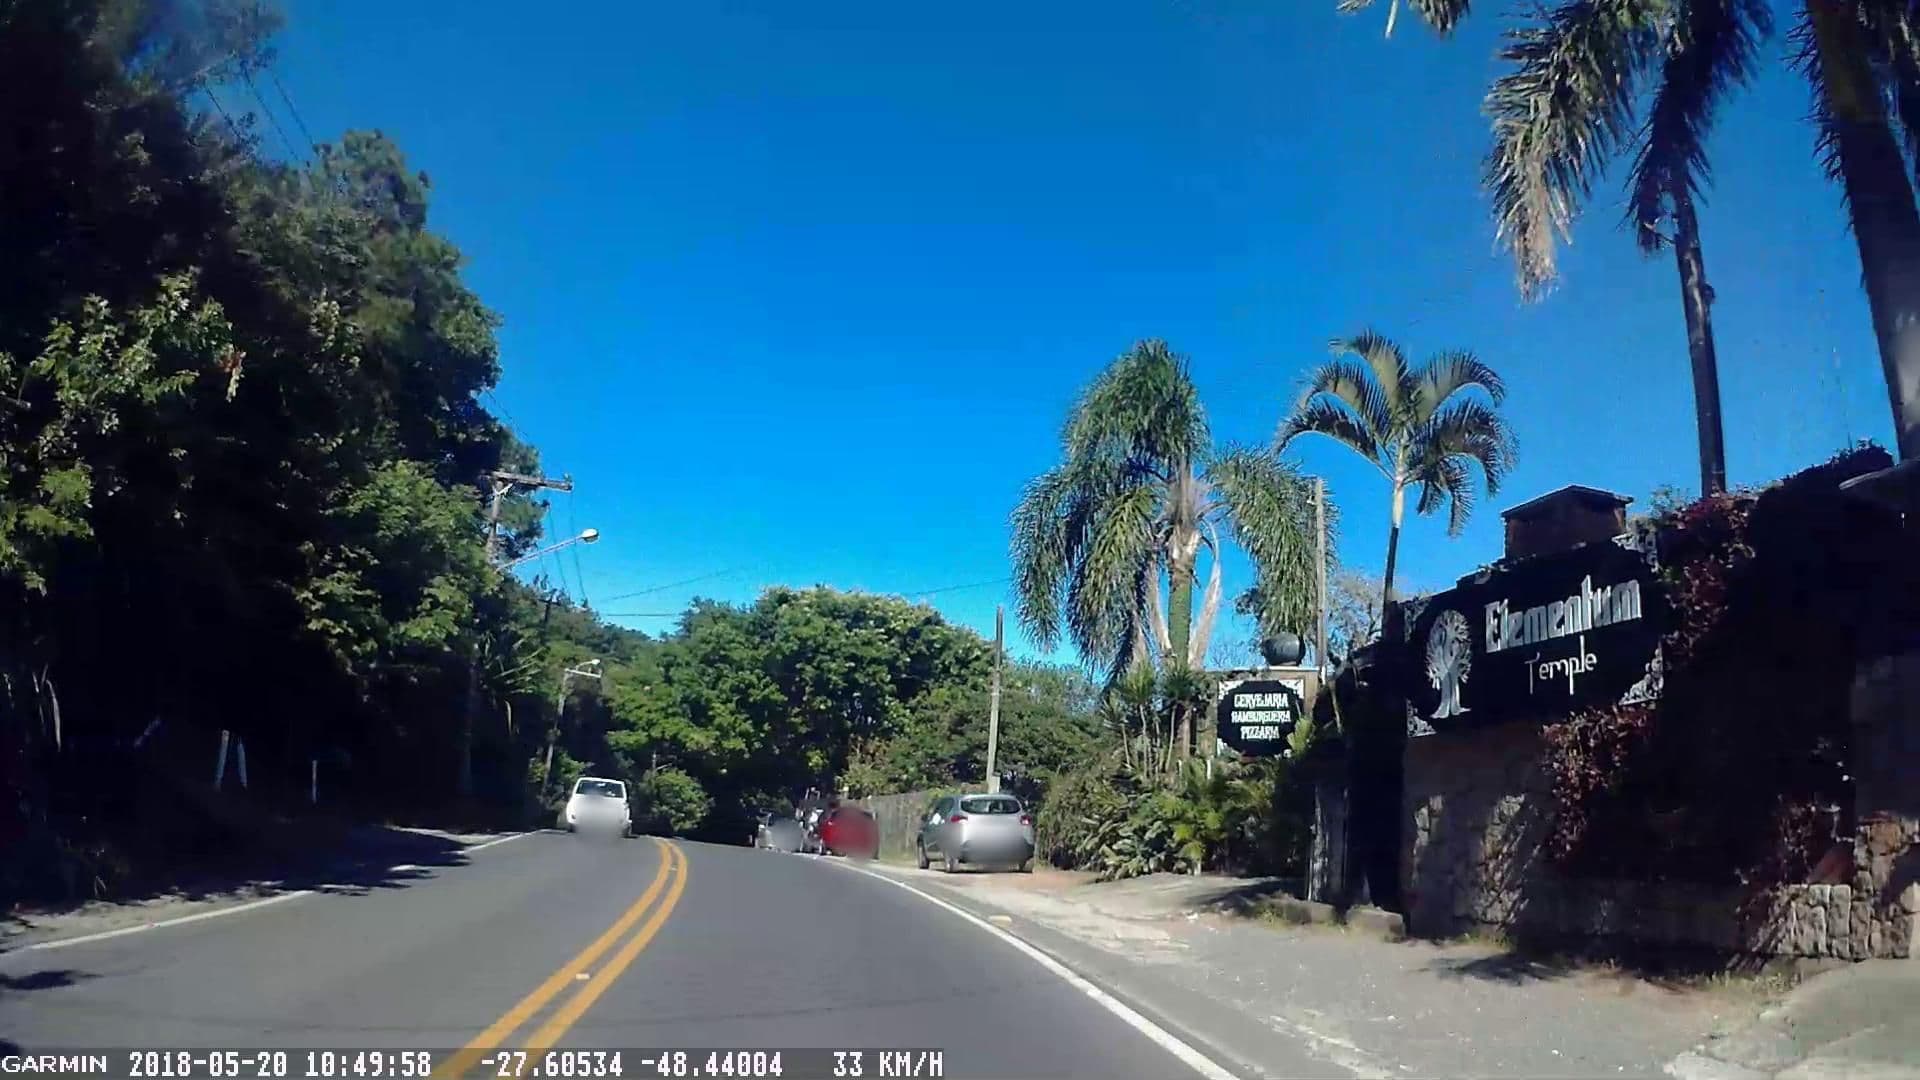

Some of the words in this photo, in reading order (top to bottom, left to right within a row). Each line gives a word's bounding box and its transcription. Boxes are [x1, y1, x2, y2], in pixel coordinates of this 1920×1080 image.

[1484, 575, 1642, 653] Elementum
[1524, 635, 1598, 695] Temple
[1233, 693, 1289, 709] CERVEJARIA
[1240, 725, 1280, 741] PIZZARIA
